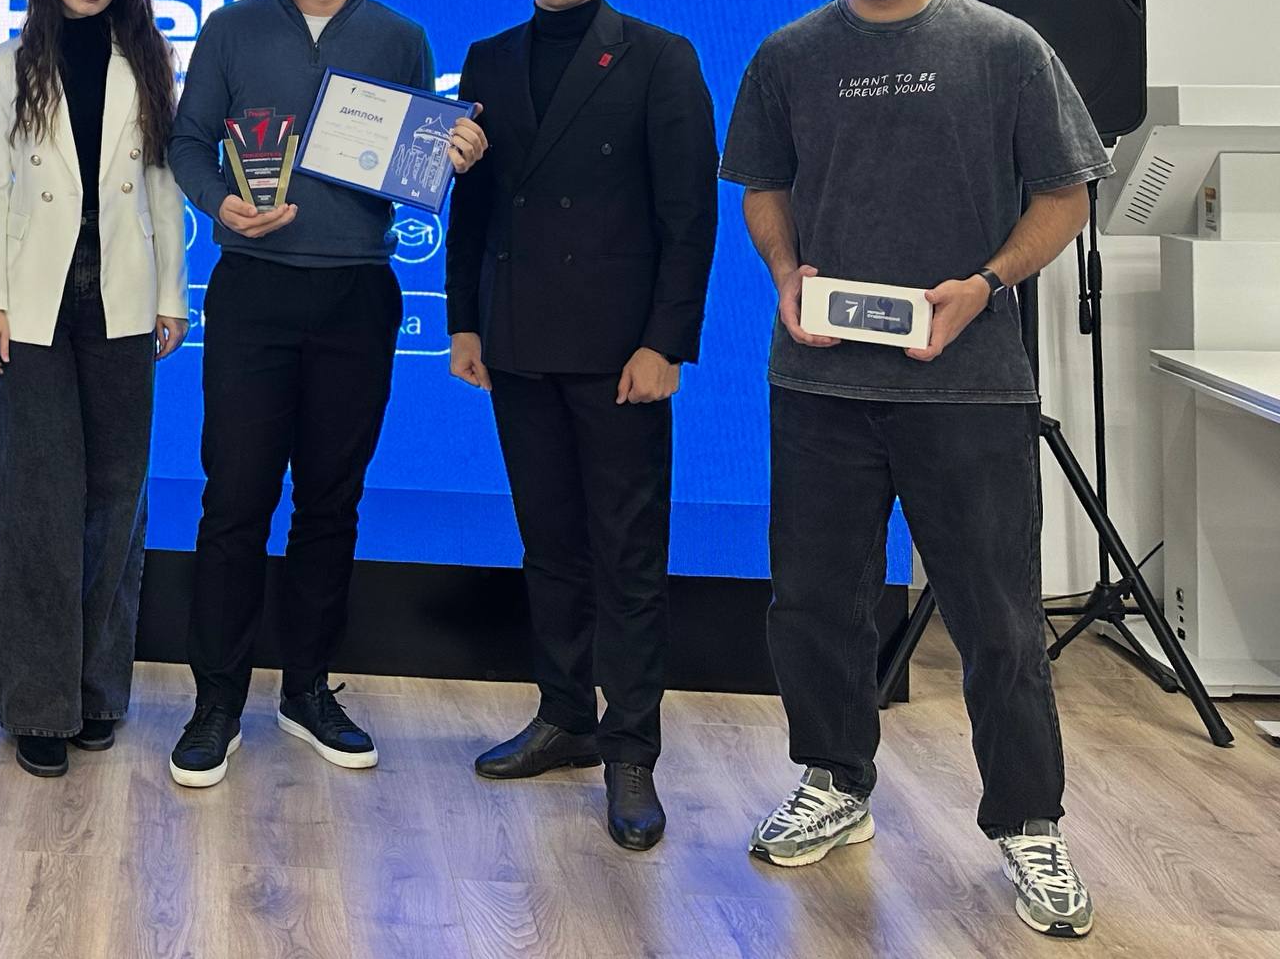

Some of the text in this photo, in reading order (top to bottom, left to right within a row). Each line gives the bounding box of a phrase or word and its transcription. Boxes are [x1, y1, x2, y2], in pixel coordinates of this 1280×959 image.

[838, 72, 937, 87] I WANT TO BE
[838, 83, 936, 97] FOREVER YOUNG
[339, 105, 384, 123] ДИПЛОМ
